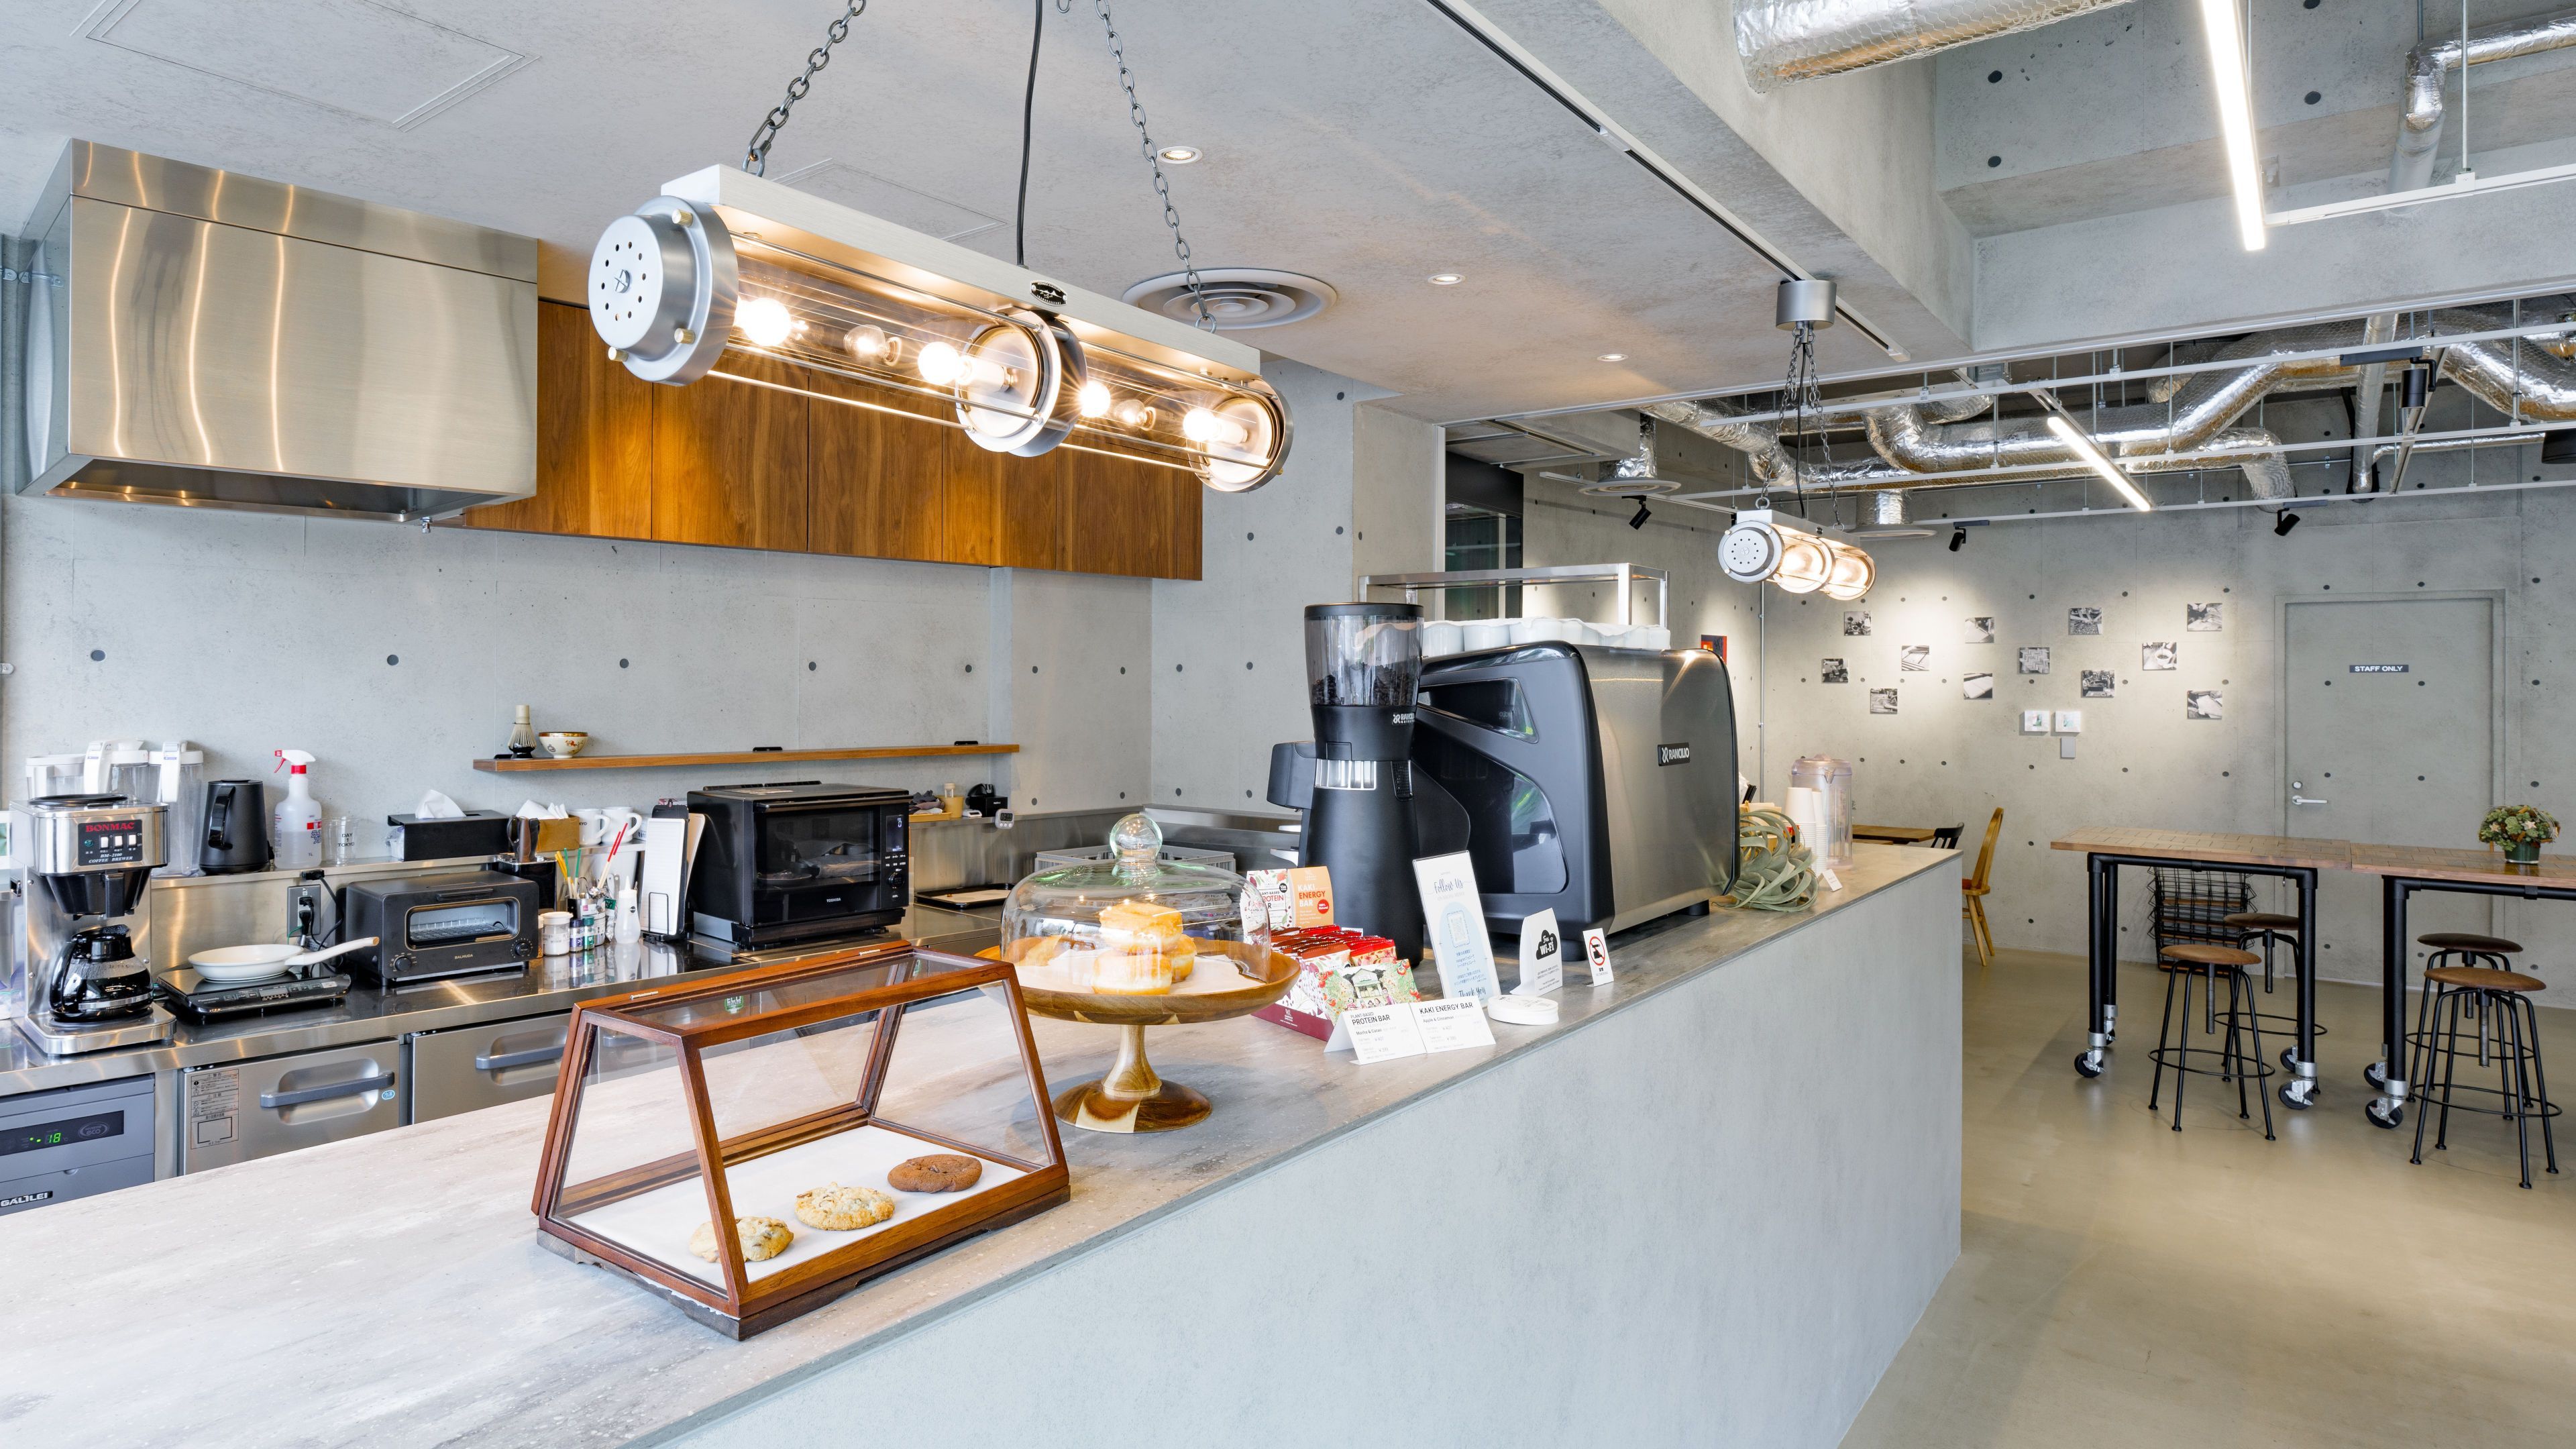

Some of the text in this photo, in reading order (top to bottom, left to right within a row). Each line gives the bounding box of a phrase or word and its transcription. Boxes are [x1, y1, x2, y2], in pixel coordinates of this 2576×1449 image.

[1668, 747, 1690, 759] RANCILIO
[86, 822, 135, 833] BONMAC
[1297, 883, 1316, 892] KAKI
[1434, 878, 1463, 894] Follow Us
[1299, 890, 1326, 900] ENERGY
[1540, 941, 1554, 955] Wi-Fi
[1458, 987, 1486, 998] Thank You
[1436, 1004, 1459, 1013] ENERGY
[1352, 1016, 1377, 1026] PROTEIN
[0, 1191, 48, 1207] GALILEI
